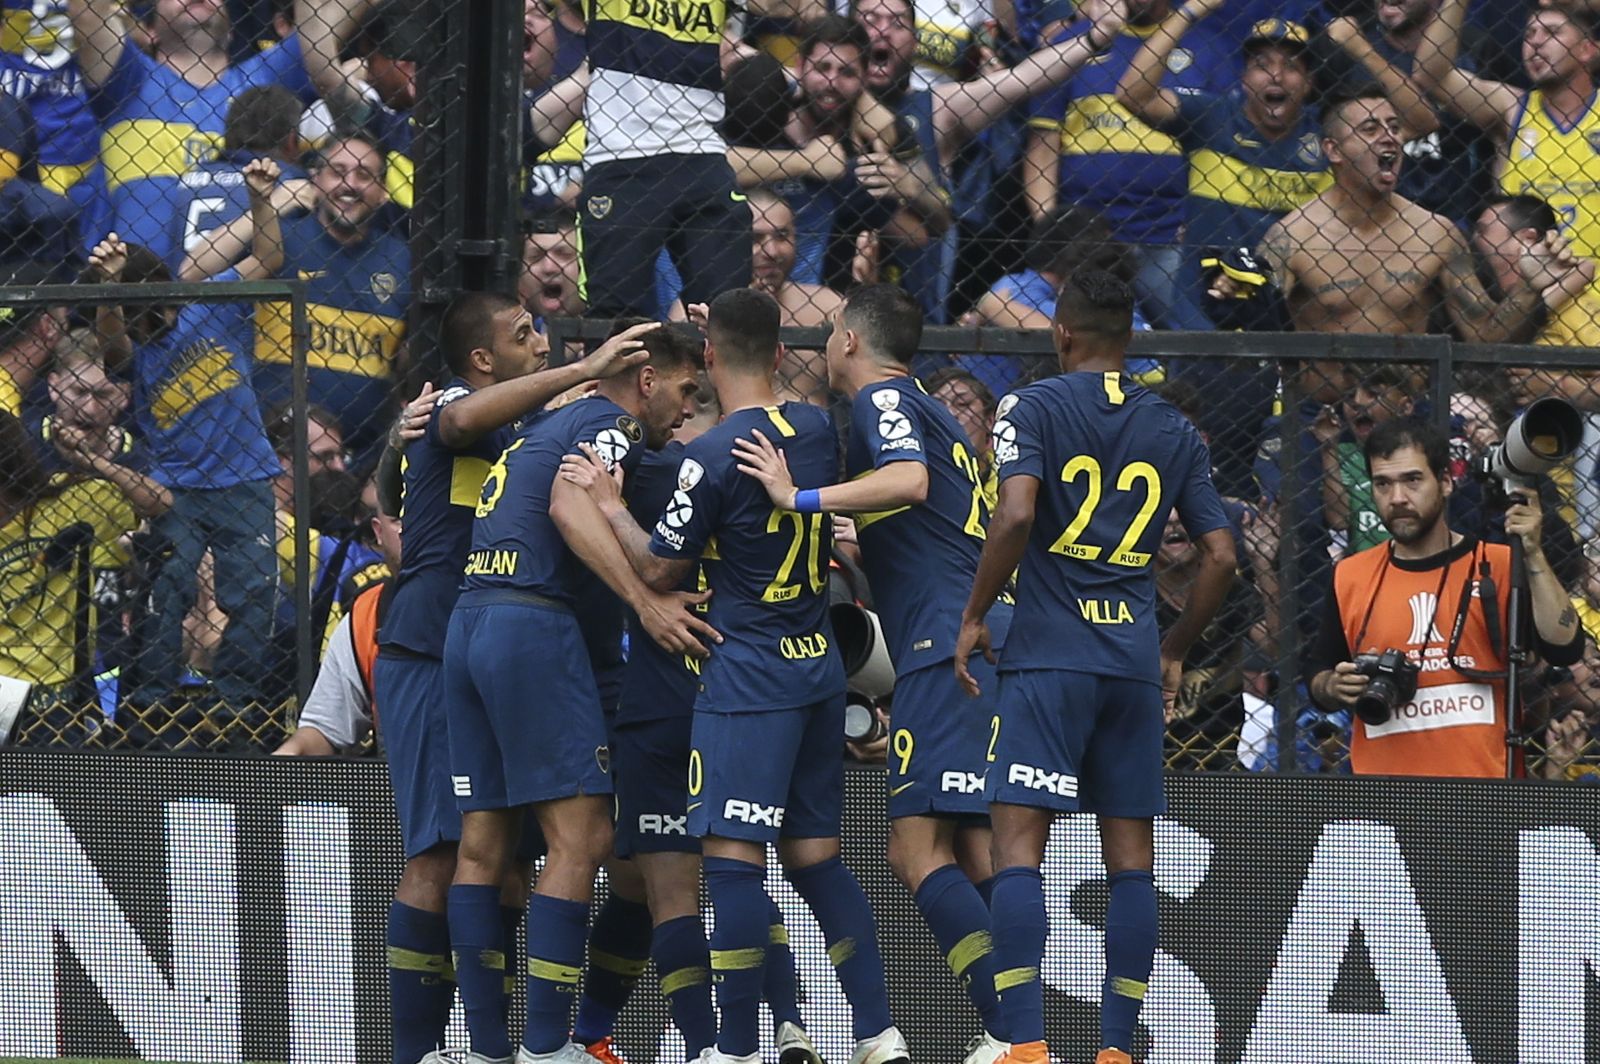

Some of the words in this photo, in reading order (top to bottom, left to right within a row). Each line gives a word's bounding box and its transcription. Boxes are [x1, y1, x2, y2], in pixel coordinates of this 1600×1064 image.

[630, 0, 716, 33] BBVA
[1048, 454, 1162, 567] 22
[1063, 545, 1087, 556] RUS
[1119, 554, 1141, 565] RUS
[773, 590, 791, 600] RUS
[1077, 598, 1134, 624] VILLA
[894, 728, 914, 775] 9
[1008, 763, 1080, 798] AXE
[723, 799, 785, 828] AXE
